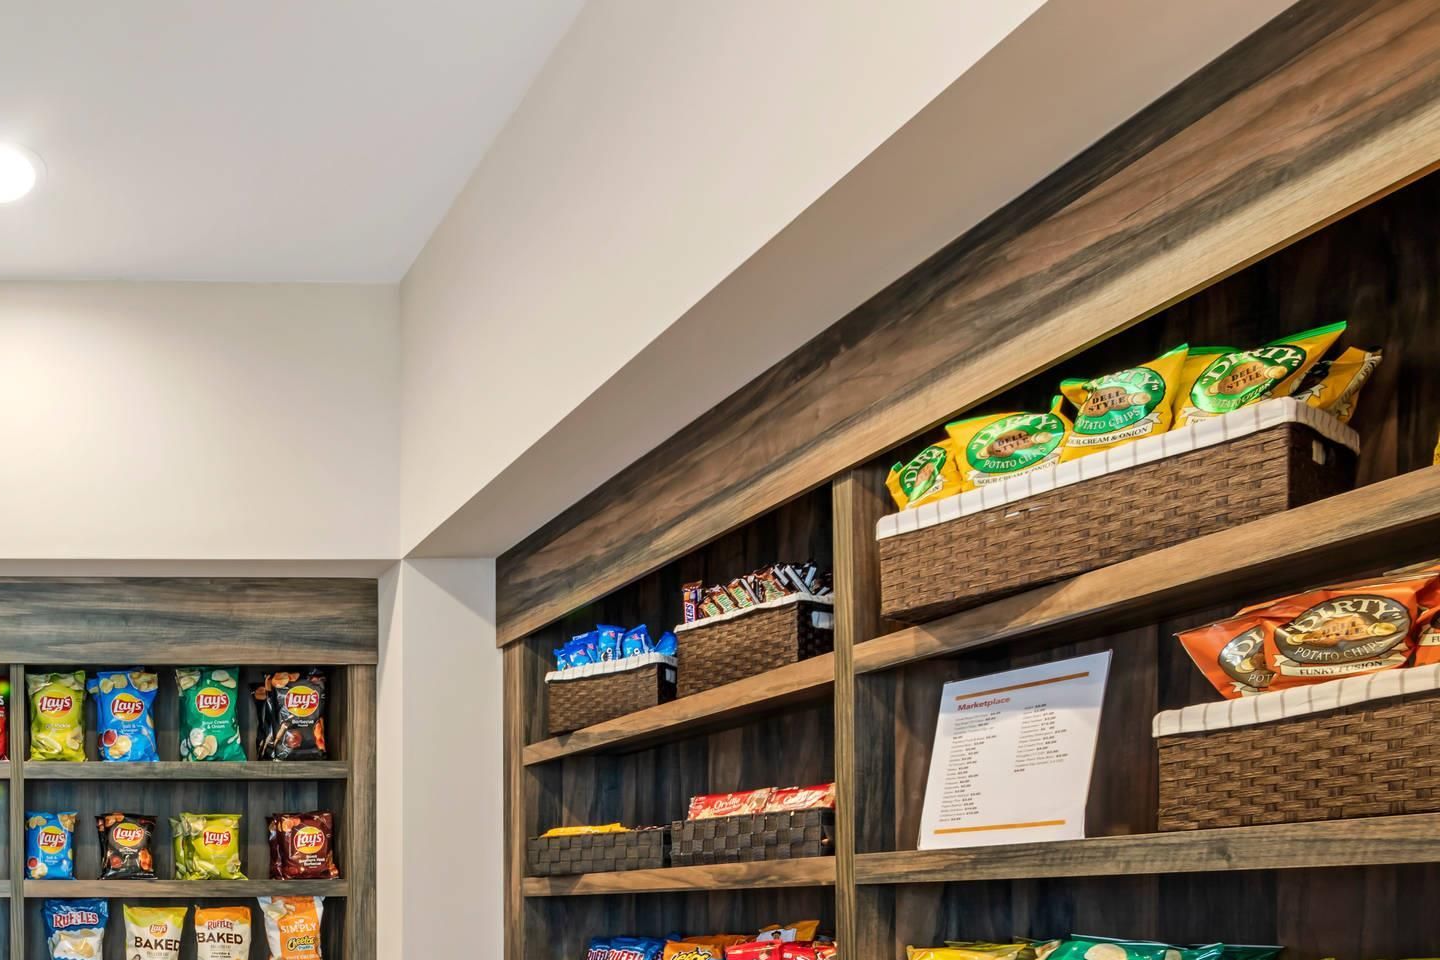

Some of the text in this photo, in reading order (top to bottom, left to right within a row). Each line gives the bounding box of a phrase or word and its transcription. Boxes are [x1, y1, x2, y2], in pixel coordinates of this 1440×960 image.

[1227, 371, 1263, 390] STYLE
[1232, 365, 1257, 382] DELI
[1089, 396, 1126, 411] STYLE
[1093, 391, 1120, 404] DELI
[1109, 408, 1141, 427] CHIPS
[1119, 425, 1148, 439] ONION
[984, 459, 1017, 469] POTATO
[1294, 639, 1385, 661] POTATO CHIPS
[1300, 667, 1334, 675] FUNKY
[40, 696, 72, 713] Lay's
[113, 699, 143, 719] Lay's
[199, 692, 227, 710] Lay's
[288, 691, 318, 711] Lay's
[957, 697, 1010, 711] Marketplace
[40, 831, 66, 847] Lay's
[116, 827, 142, 841] Lay's
[205, 831, 230, 845] Lay's
[296, 831, 323, 848] Lay's
[53, 911, 99, 927] RUFFLES
[207, 919, 234, 931] RUFFLES
[281, 922, 317, 933] SIMPLY
[134, 936, 181, 952] BAKED
[197, 932, 244, 945] BAKED
